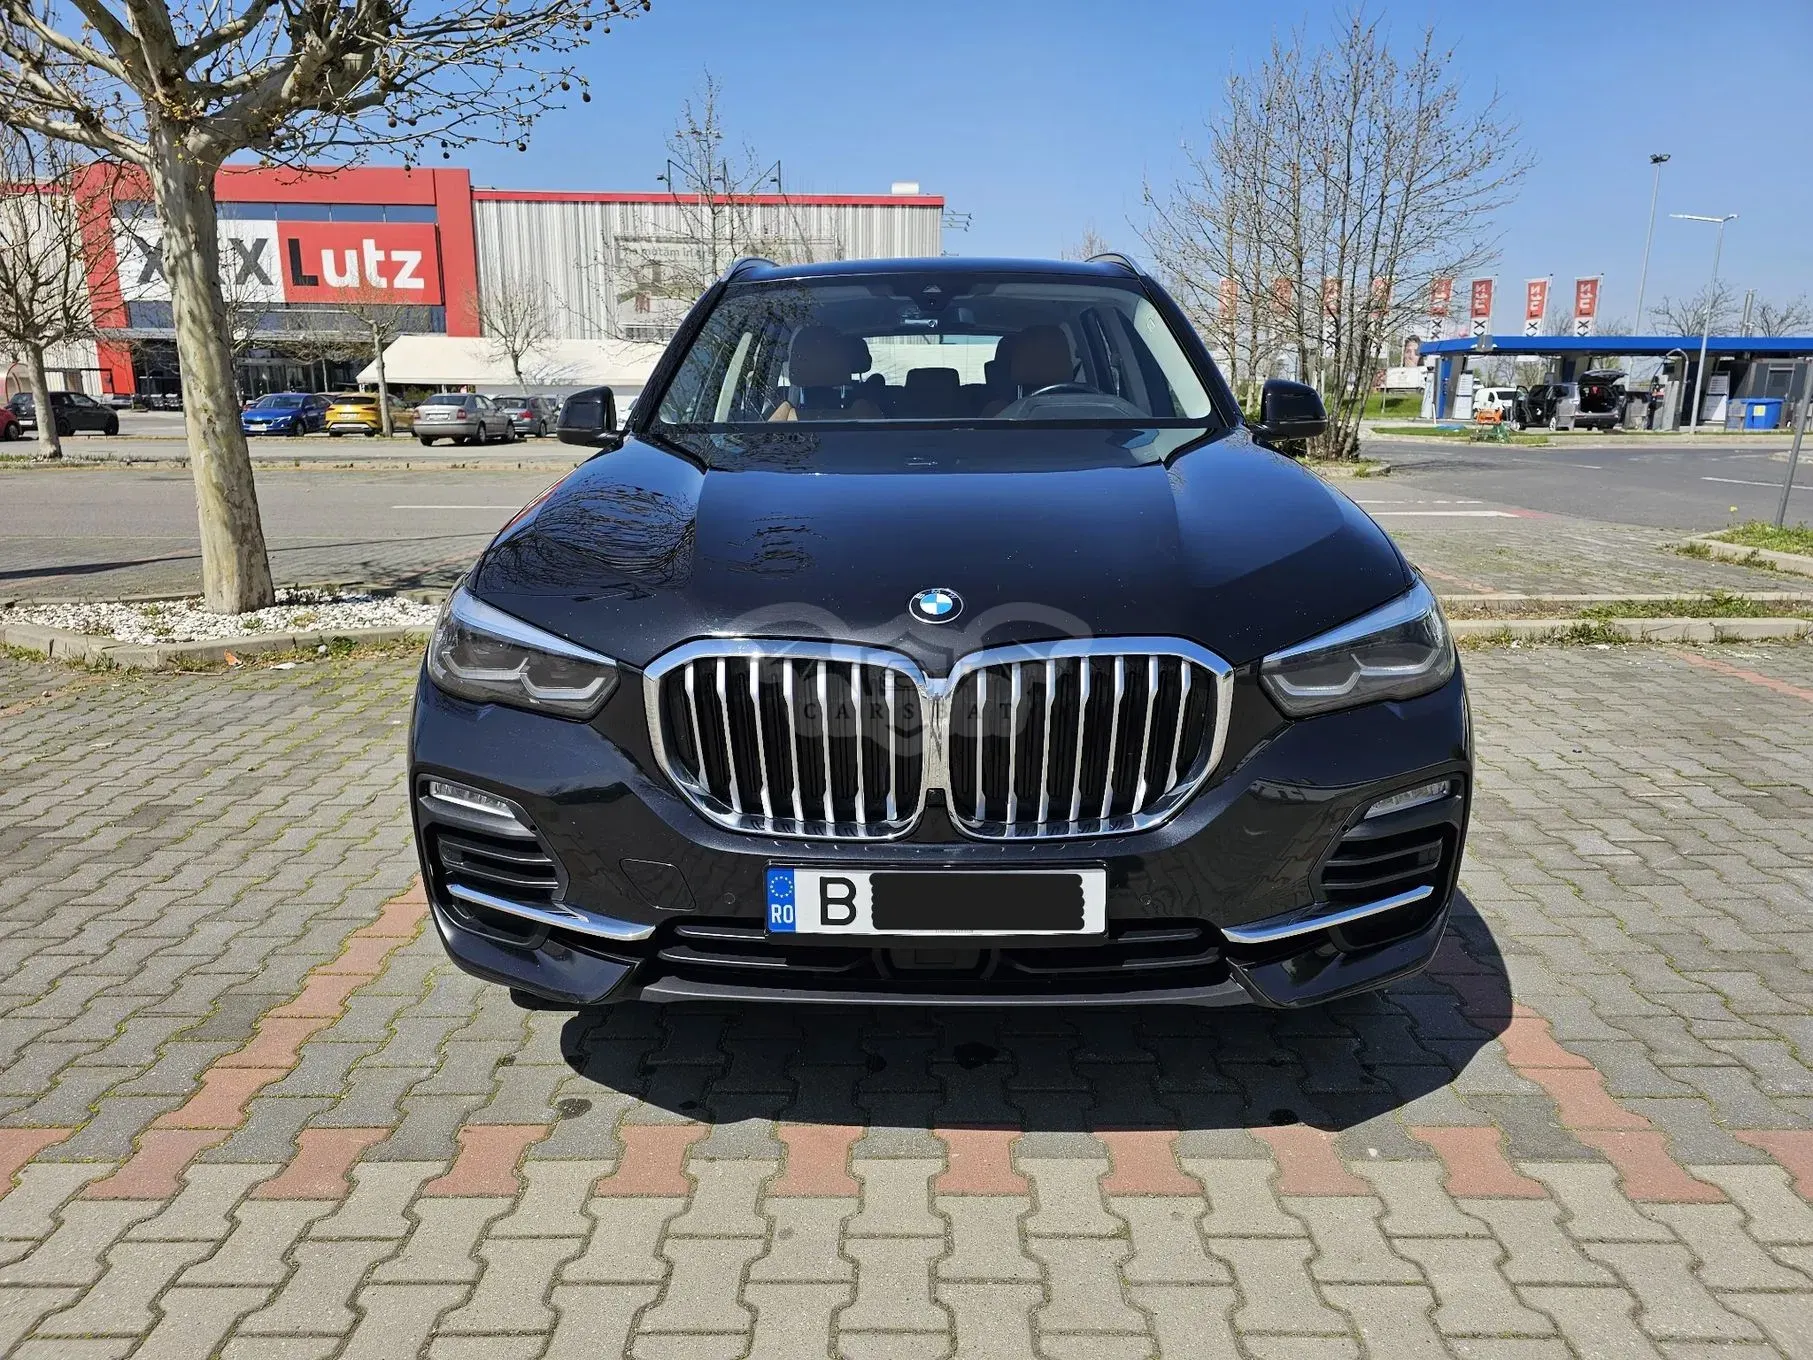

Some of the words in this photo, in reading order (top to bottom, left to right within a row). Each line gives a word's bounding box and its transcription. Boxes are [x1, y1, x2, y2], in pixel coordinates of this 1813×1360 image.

[136, 237, 425, 289] XXLutz
[771, 904, 794, 924] RO
[819, 876, 857, 926] B
